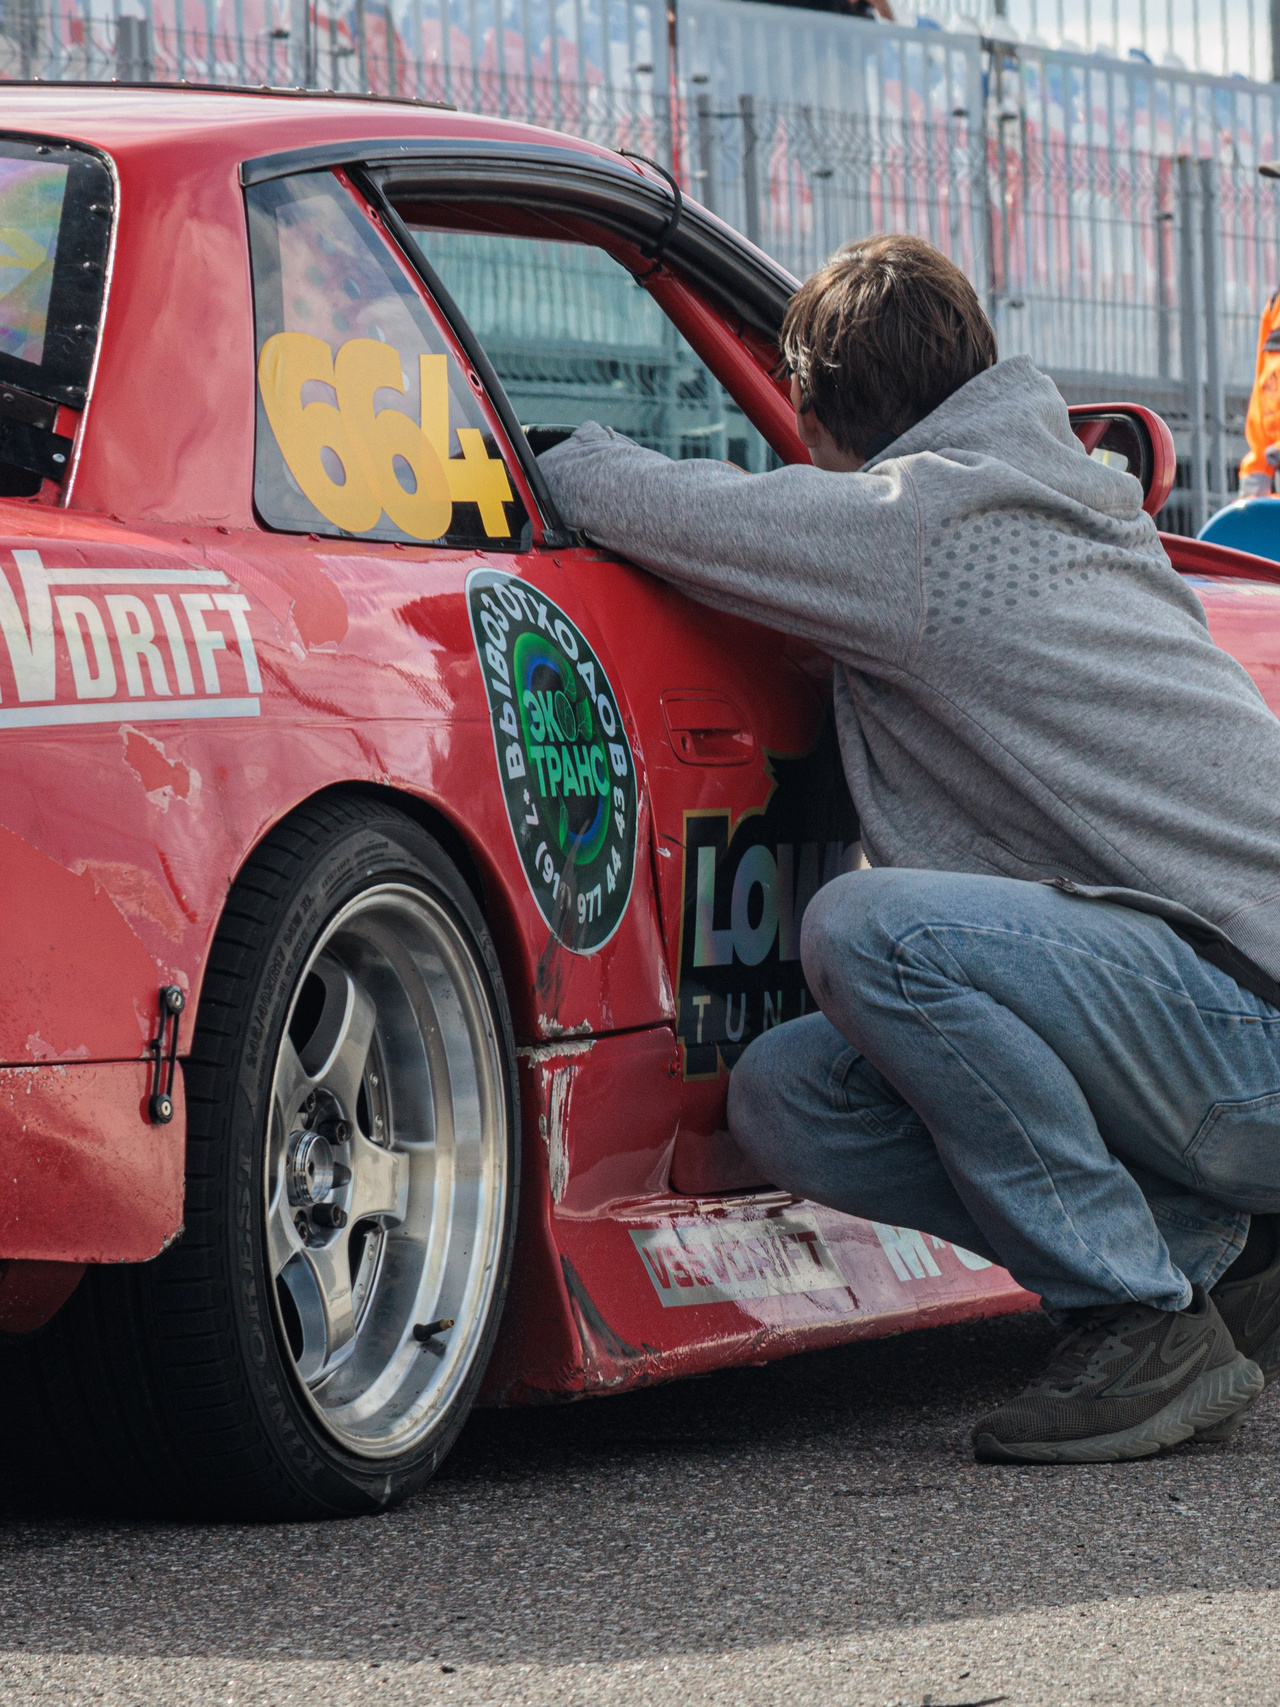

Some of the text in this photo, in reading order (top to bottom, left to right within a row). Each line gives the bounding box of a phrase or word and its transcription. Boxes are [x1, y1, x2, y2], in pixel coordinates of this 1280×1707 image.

[258, 332, 514, 540] 664
[480, 583, 628, 780] ВЫВОЗ ОТХОДОВ
[530, 744, 611, 797] ТРАНС
[577, 883, 602, 925] 977
[693, 838, 862, 968] LOW
